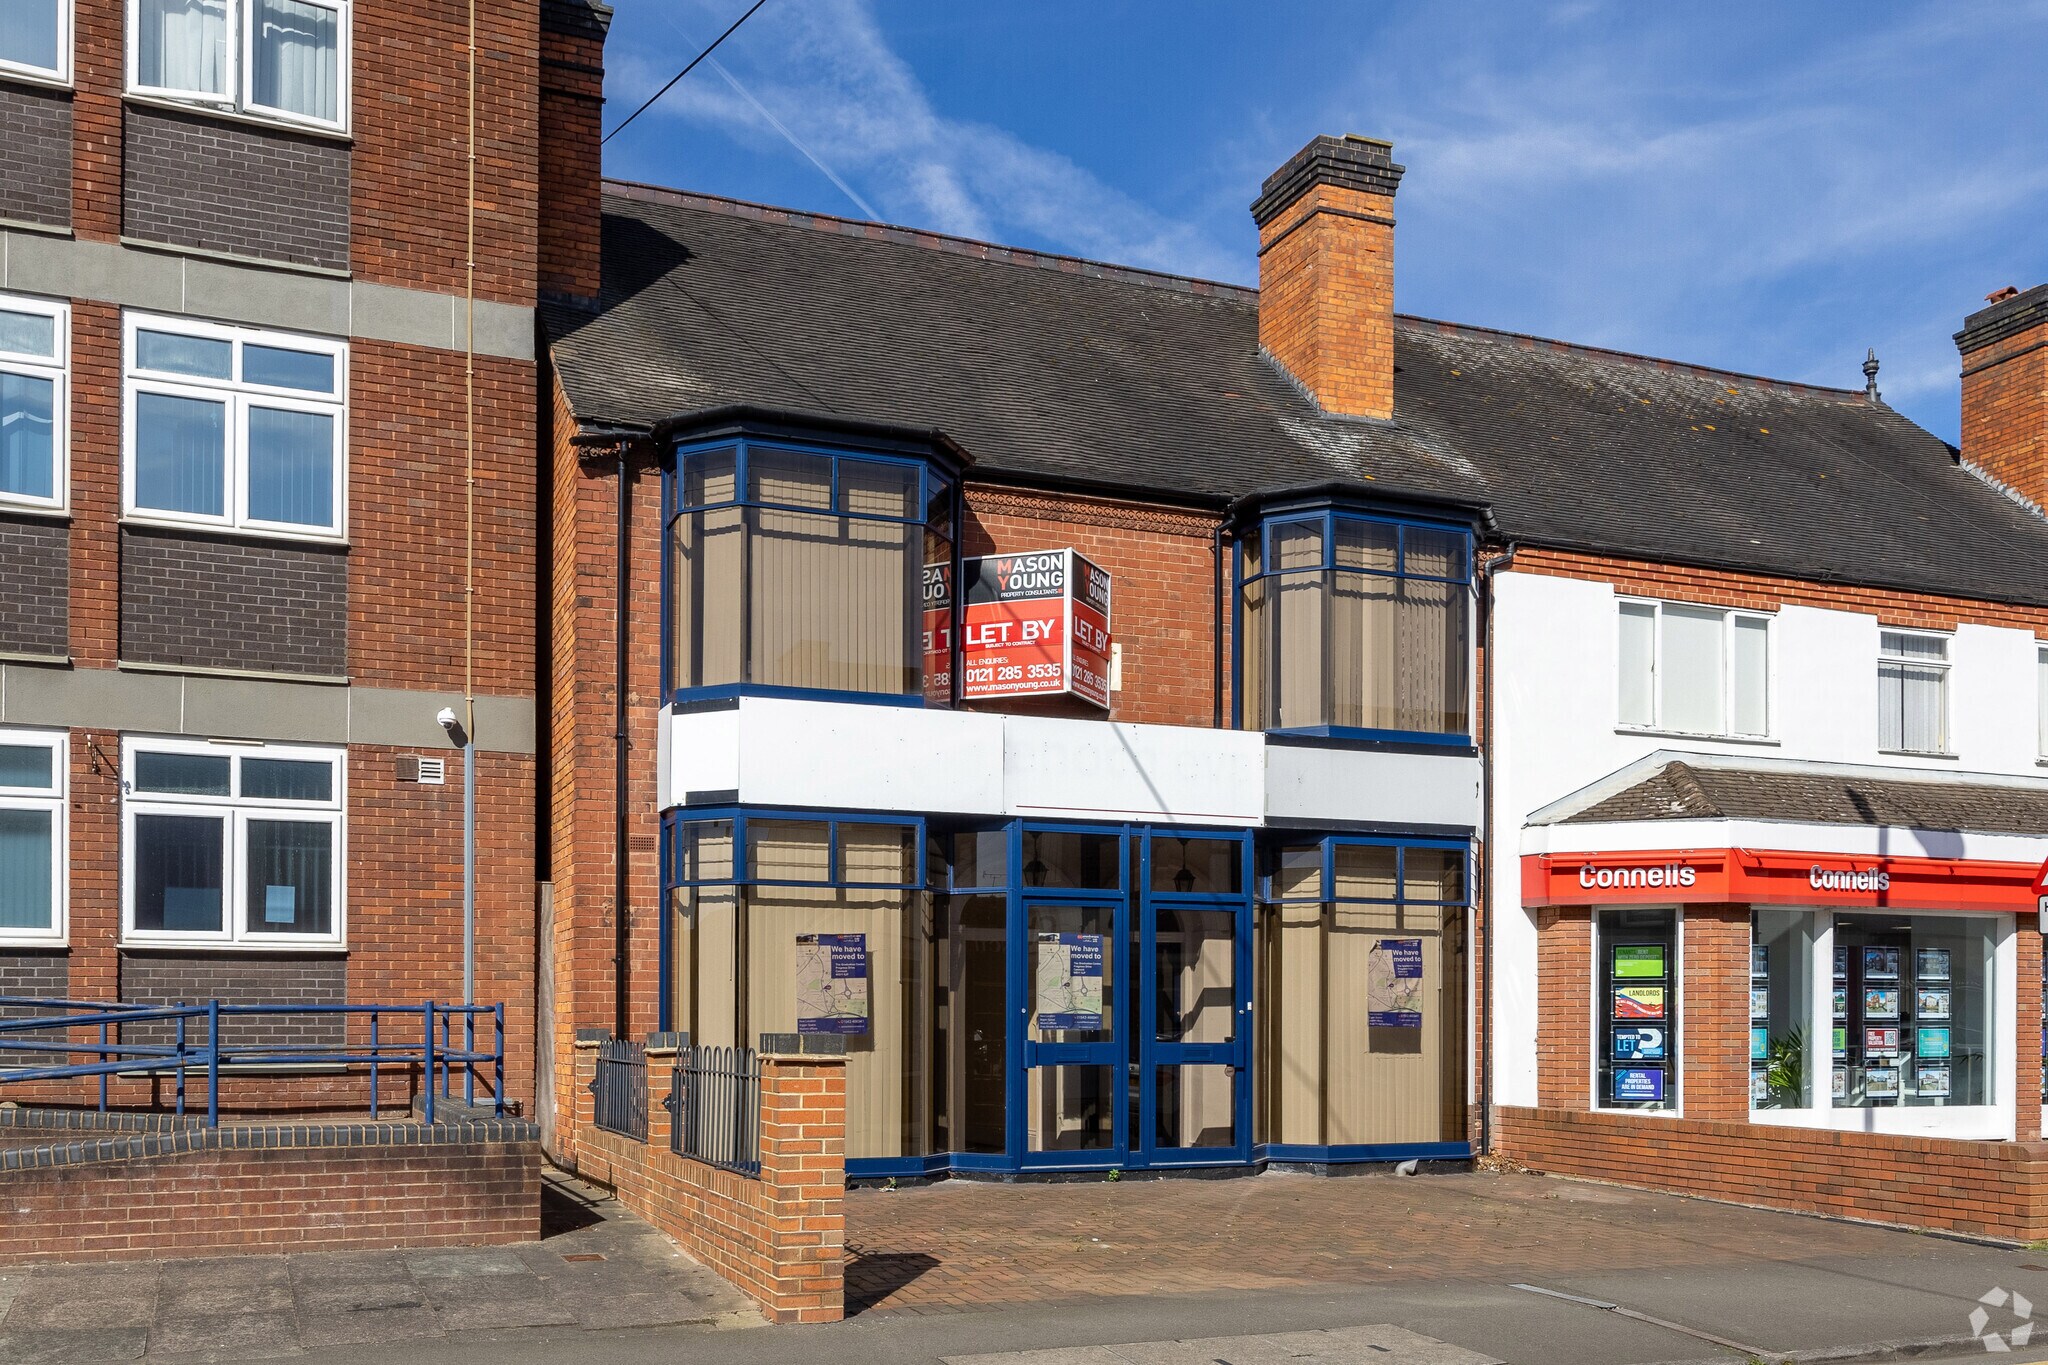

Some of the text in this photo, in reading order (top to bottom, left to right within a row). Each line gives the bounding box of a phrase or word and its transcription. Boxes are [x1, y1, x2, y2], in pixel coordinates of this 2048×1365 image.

[997, 554, 1063, 575] MASON
[997, 571, 1063, 591] YOUNG
[1083, 562, 1109, 591] MASON
[1025, 588, 1058, 597] CONSULTANTS
[1084, 578, 1109, 606] YOUNG
[966, 622, 1013, 646] LET
[1022, 619, 1055, 640] BY
[1074, 616, 1093, 643] LET
[1095, 629, 1109, 652] BY
[966, 663, 1061, 683] 0121 285 3535
[1083, 669, 1094, 686] 285
[966, 679, 1061, 692] www.masonyoung.co.uk
[1579, 863, 1697, 890] Connells
[1809, 864, 1891, 891] Connells
[1083, 945, 1099, 953] have
[1617, 1039, 1636, 1052] LET
